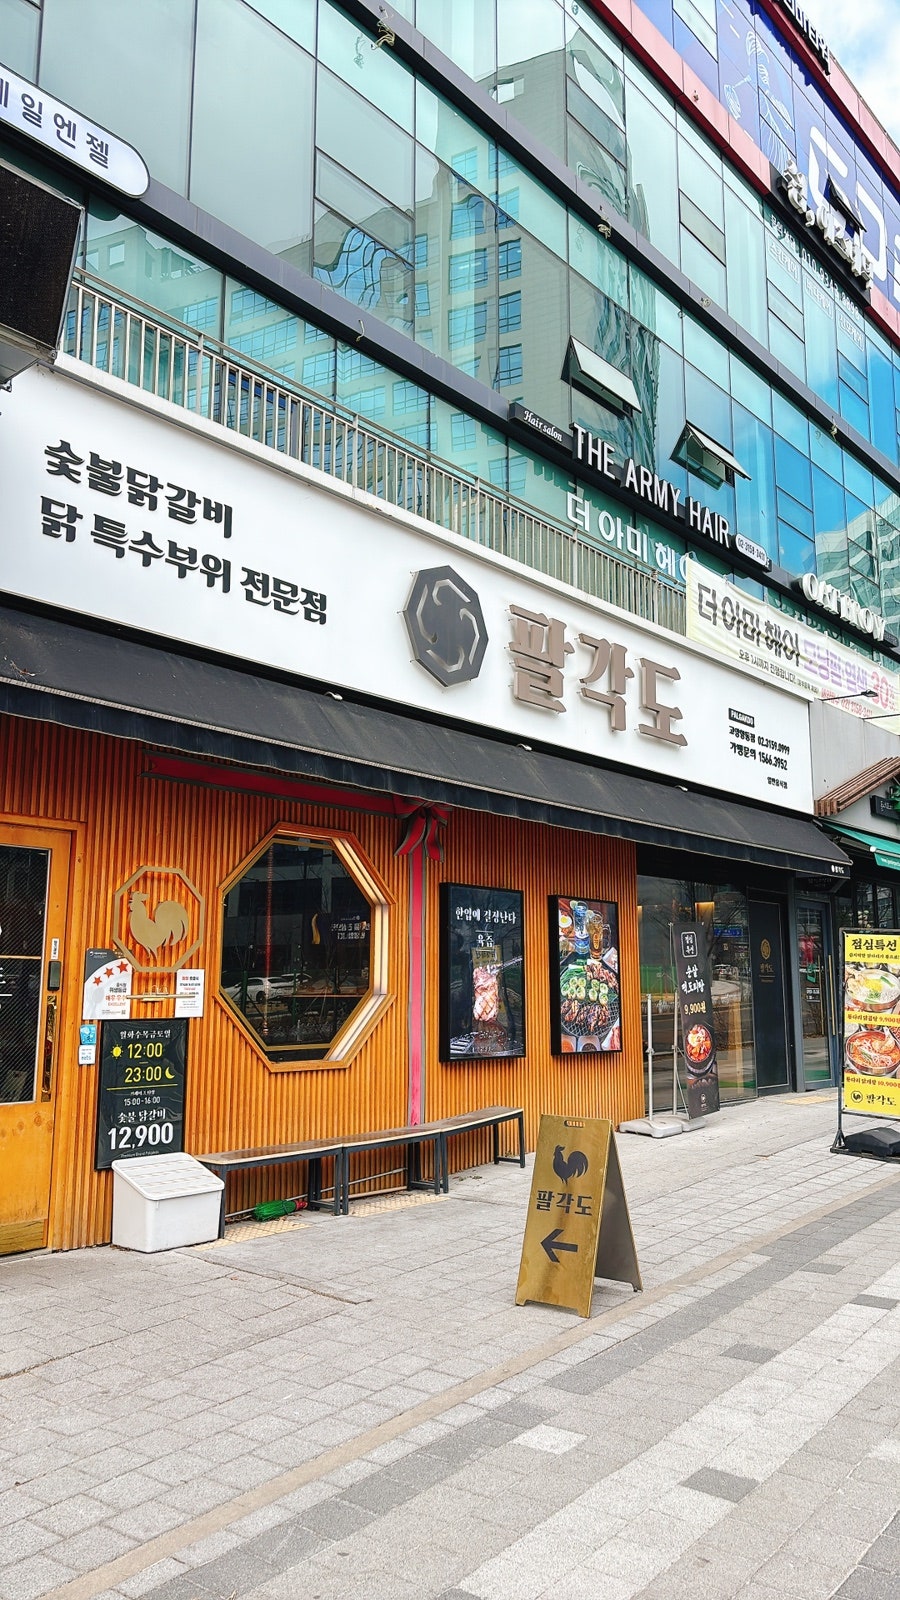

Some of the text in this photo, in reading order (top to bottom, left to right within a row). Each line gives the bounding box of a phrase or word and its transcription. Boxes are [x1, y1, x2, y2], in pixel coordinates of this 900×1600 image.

[523, 410, 562, 442] Hair salon
[44, 440, 233, 539] 숯불닭갈비
[572, 422, 730, 549] THE ARMY HAIR
[567, 491, 590, 532] 더
[598, 511, 647, 563] 아미
[40, 496, 327, 625] 닭 특수부위 전문점
[508, 604, 688, 746] 팔각도
[730, 742, 756, 760] 가맹문의
[455, 906, 481, 922] 한입에
[477, 934, 495, 948] 육즙
[851, 938, 897, 951] 점심특선
[684, 1001, 706, 1015] 9,900원
[120, 1029, 171, 1039] 월화수목금토일
[127, 1042, 163, 1059] 12:00
[124, 1066, 162, 1083] 23:00
[866, 1093, 897, 1106] 팔각도
[118, 1108, 166, 1123] 숯불 닭갈비
[107, 1122, 173, 1150] 12,900
[536, 1190, 592, 1216] 팔각도
